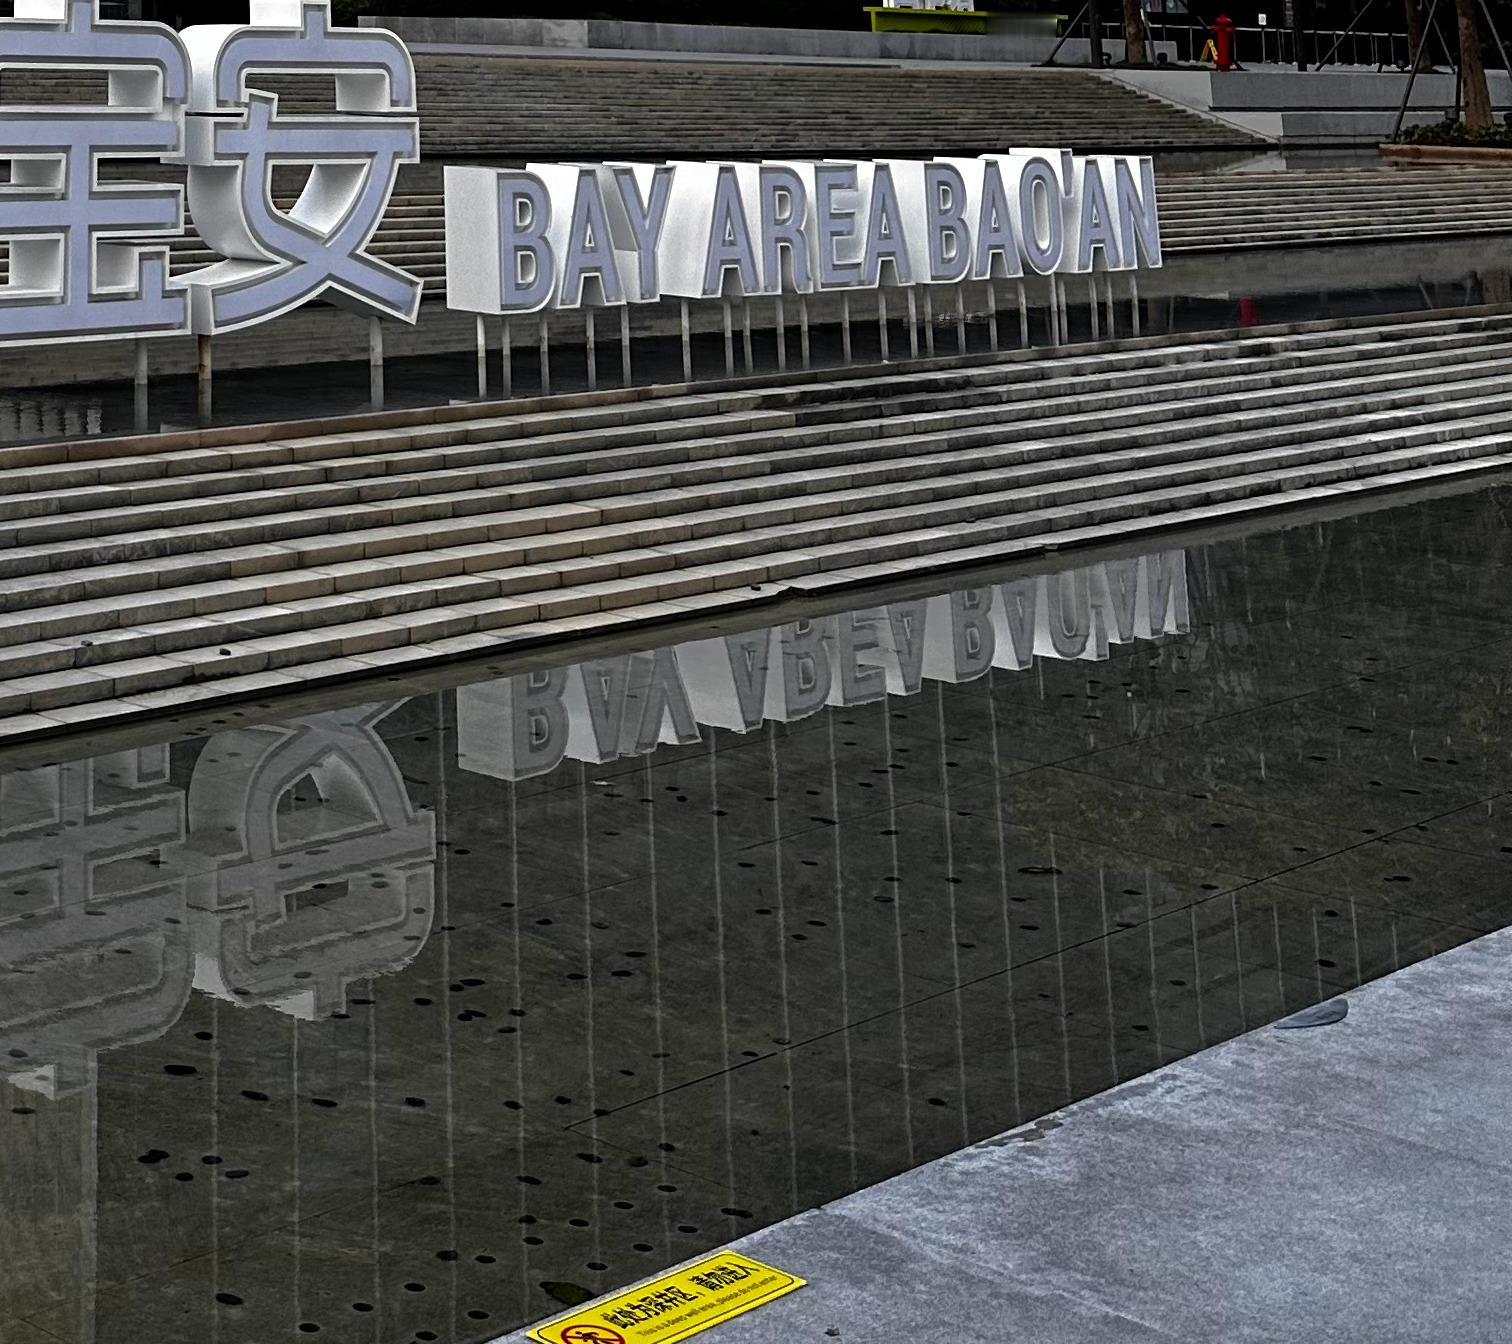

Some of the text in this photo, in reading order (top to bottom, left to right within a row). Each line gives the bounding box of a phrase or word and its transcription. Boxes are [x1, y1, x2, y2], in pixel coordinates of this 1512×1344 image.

[494, 148, 1164, 315] BAY AREA BAO'AN
